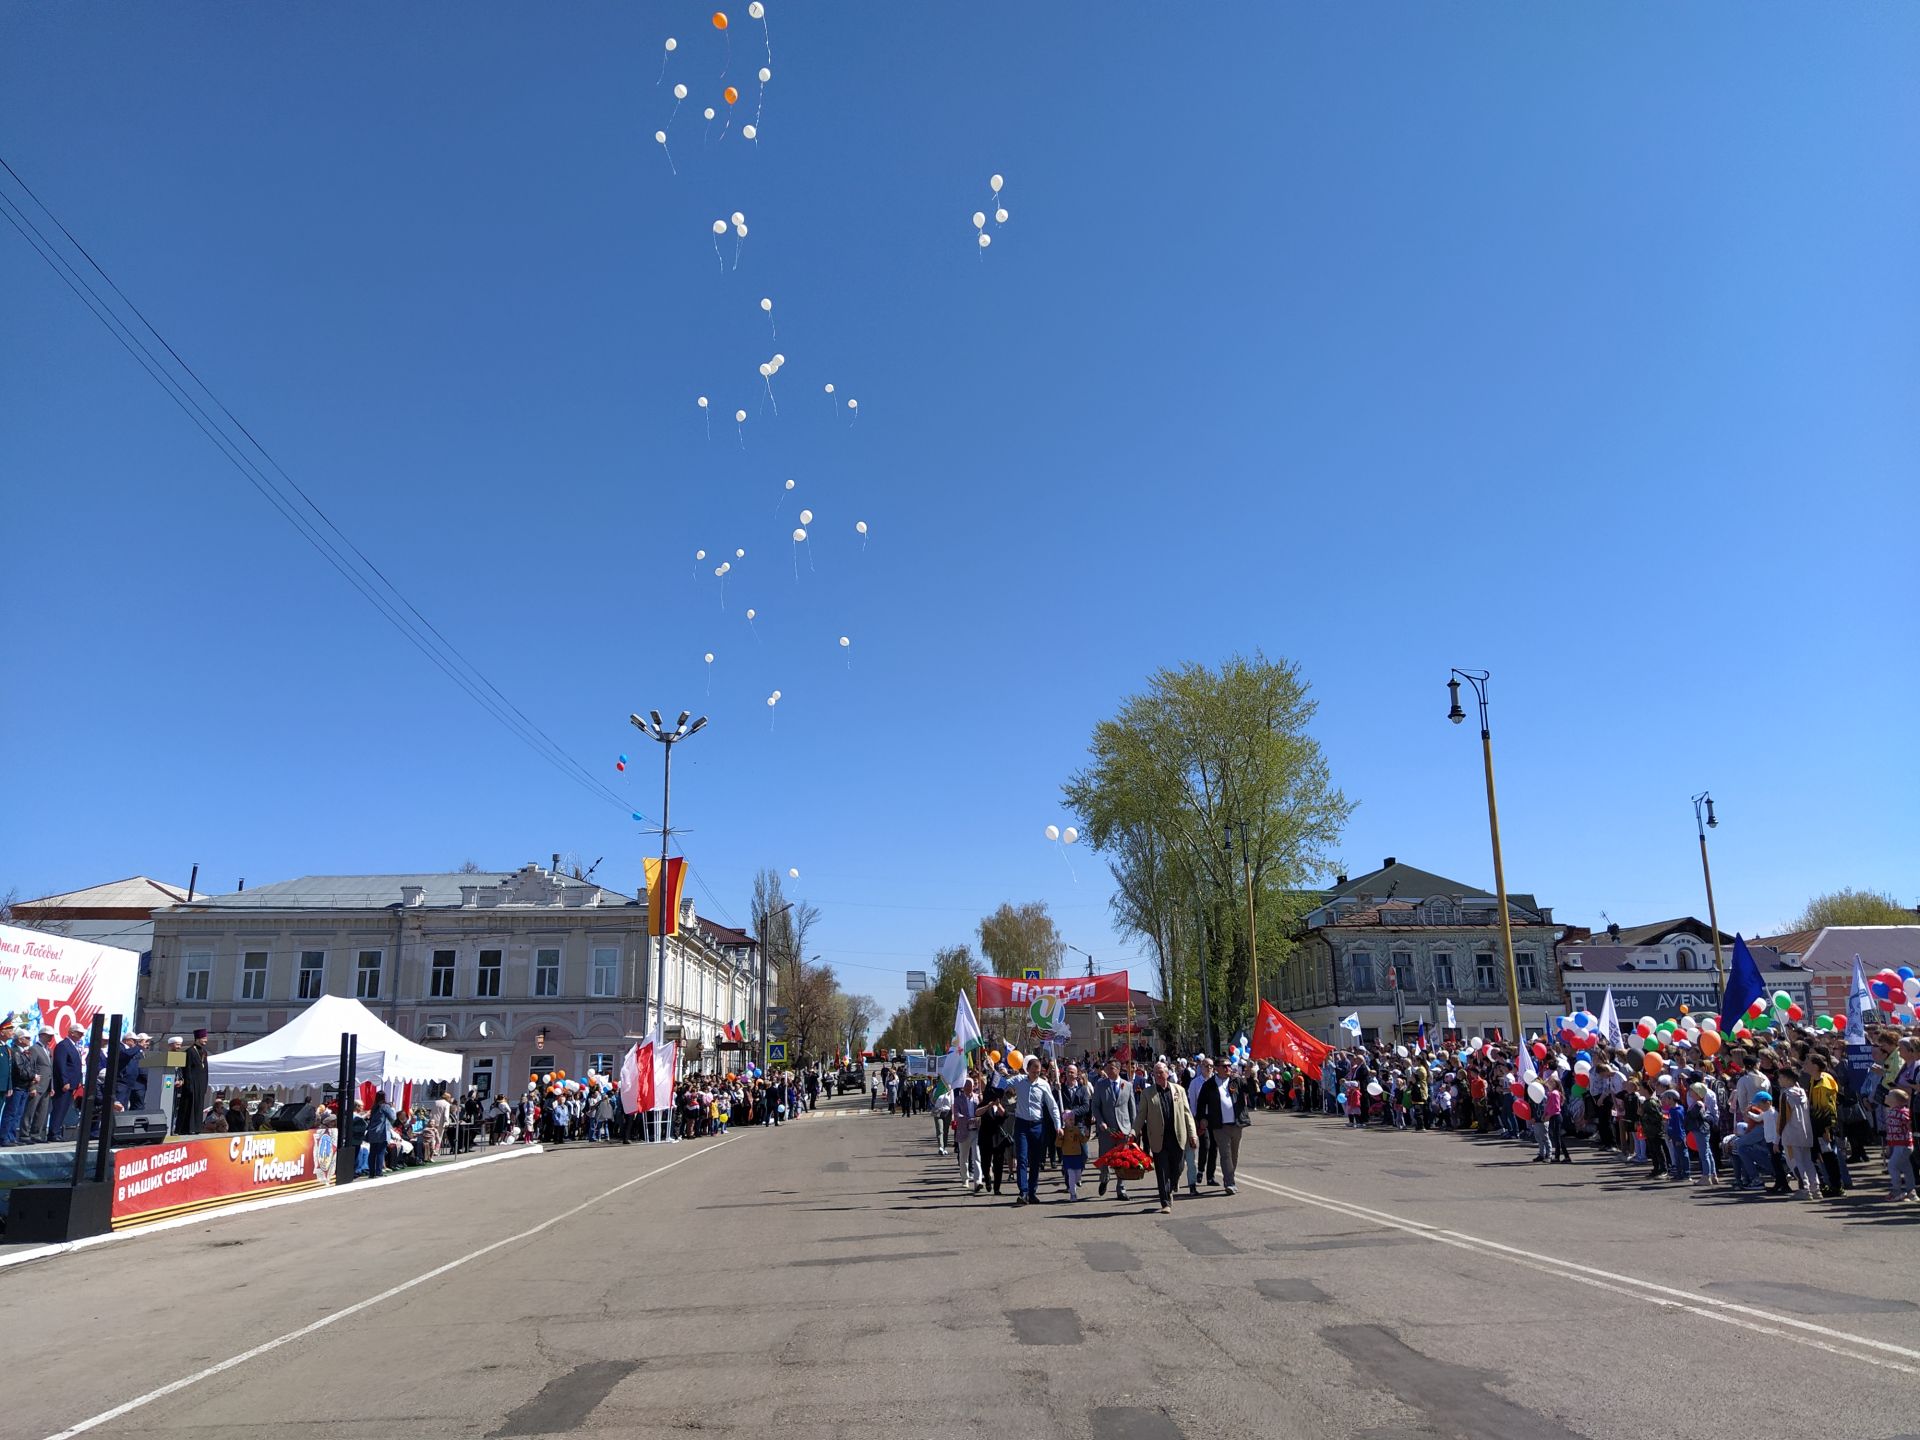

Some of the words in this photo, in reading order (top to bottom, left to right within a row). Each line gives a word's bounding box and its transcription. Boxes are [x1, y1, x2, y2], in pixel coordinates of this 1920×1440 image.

[23, 942, 63, 960] Победы!
[1614, 995, 1639, 1007] café
[229, 1136, 241, 1160] С
[241, 1134, 276, 1162] Днем
[119, 1158, 149, 1180] ВАША
[150, 1146, 188, 1168] ПОБЕДА
[253, 1153, 305, 1184] Победы!
[118, 1187, 126, 1201] В
[127, 1176, 163, 1199] НАШИХ
[164, 1158, 208, 1184] СЕРДЦАХ!
